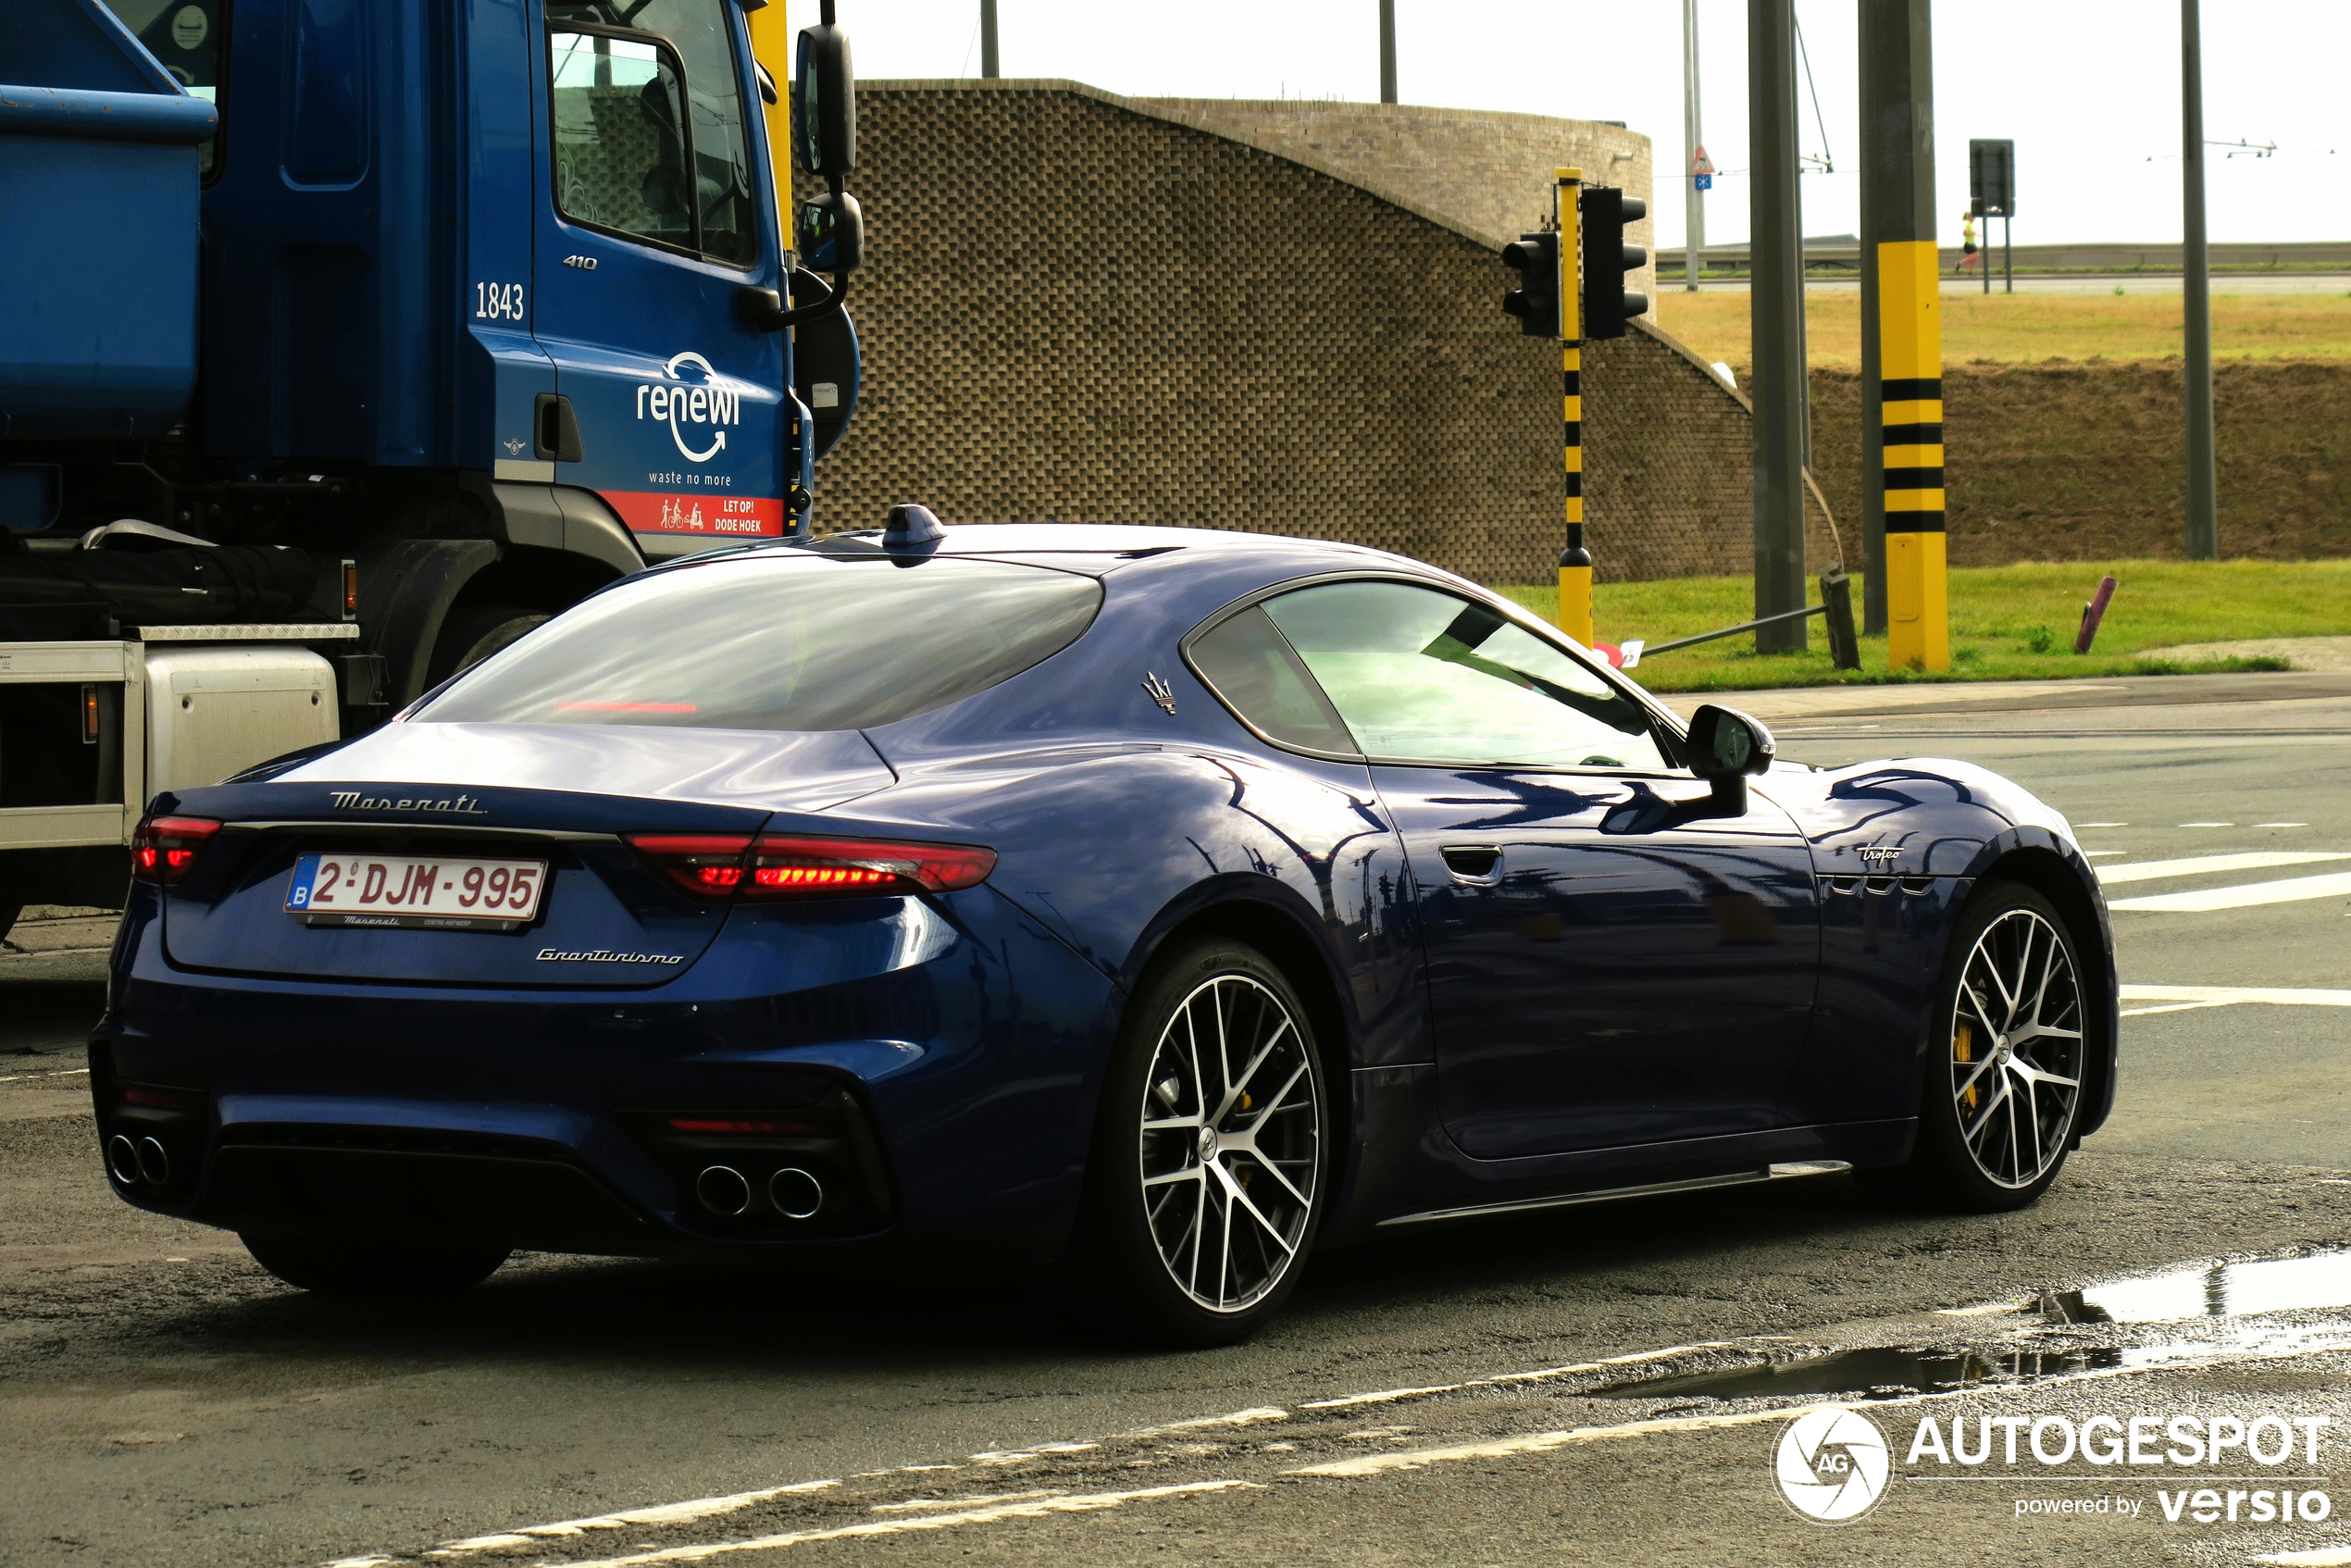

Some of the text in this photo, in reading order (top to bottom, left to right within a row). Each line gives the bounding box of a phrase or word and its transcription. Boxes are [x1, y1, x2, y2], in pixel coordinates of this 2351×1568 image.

[562, 255, 598, 270] 410
[476, 281, 524, 321] 1843
[649, 471, 731, 487] waste no more
[723, 500, 754, 514] LET OP!
[715, 517, 762, 533] DODE HOEK
[330, 791, 485, 815] Maserati
[292, 862, 538, 910] B 2-DJM-995
[343, 915, 400, 926] Maserati
[535, 948, 684, 964] GranTurismo
